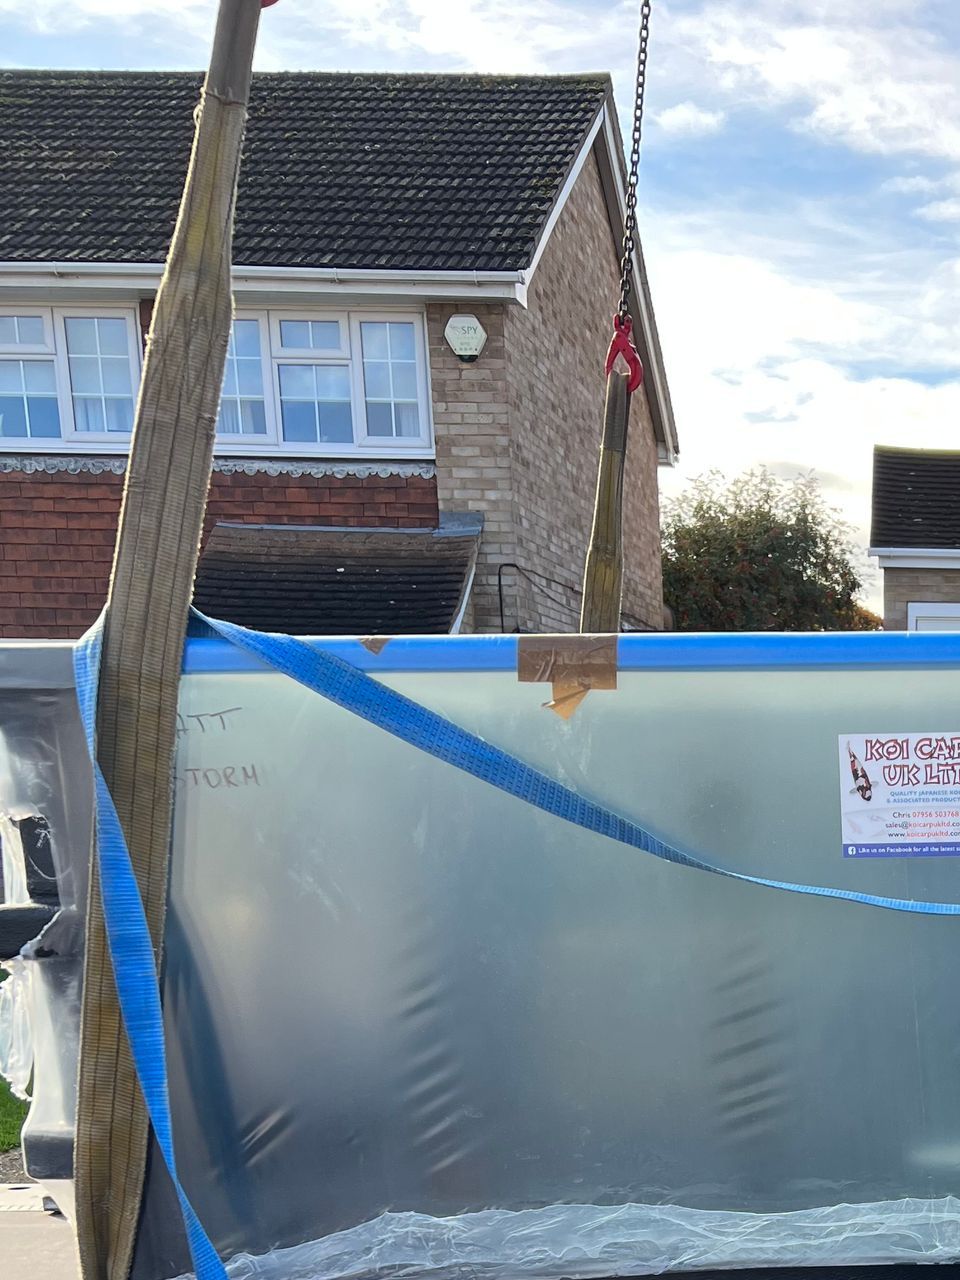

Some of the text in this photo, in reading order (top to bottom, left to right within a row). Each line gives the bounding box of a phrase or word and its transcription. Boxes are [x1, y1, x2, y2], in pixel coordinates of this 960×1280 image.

[461, 326, 478, 335] SPY
[864, 738, 910, 762] KOI
[882, 764, 920, 787] UK
